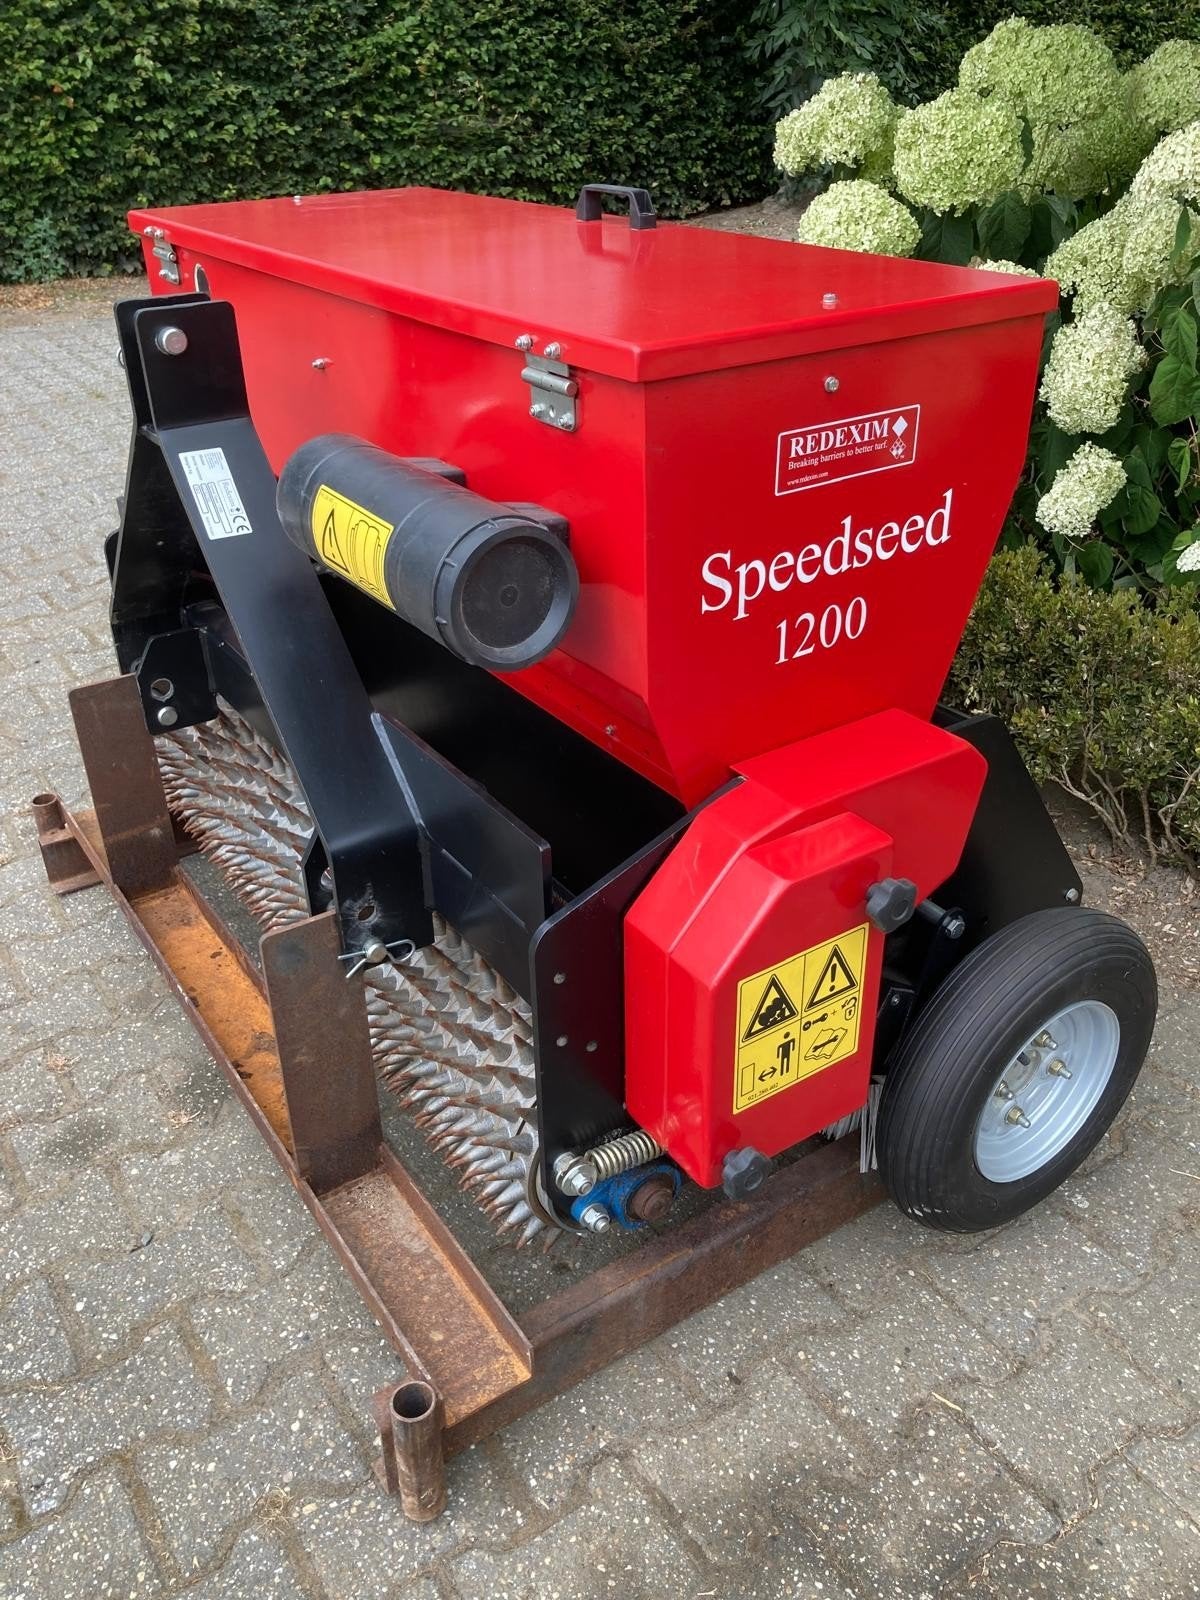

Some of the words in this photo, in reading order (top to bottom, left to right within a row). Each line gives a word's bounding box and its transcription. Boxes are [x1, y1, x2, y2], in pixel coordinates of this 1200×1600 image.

[788, 458, 819, 470] Breaking
[820, 451, 846, 463] barriers
[855, 444, 873, 455] better
[874, 440, 888, 450] turf.
[789, 417, 890, 458] REDEXIM
[787, 471, 829, 486] www.redexim.com
[701, 488, 953, 621] Speedseed
[775, 596, 867, 664] 1200
